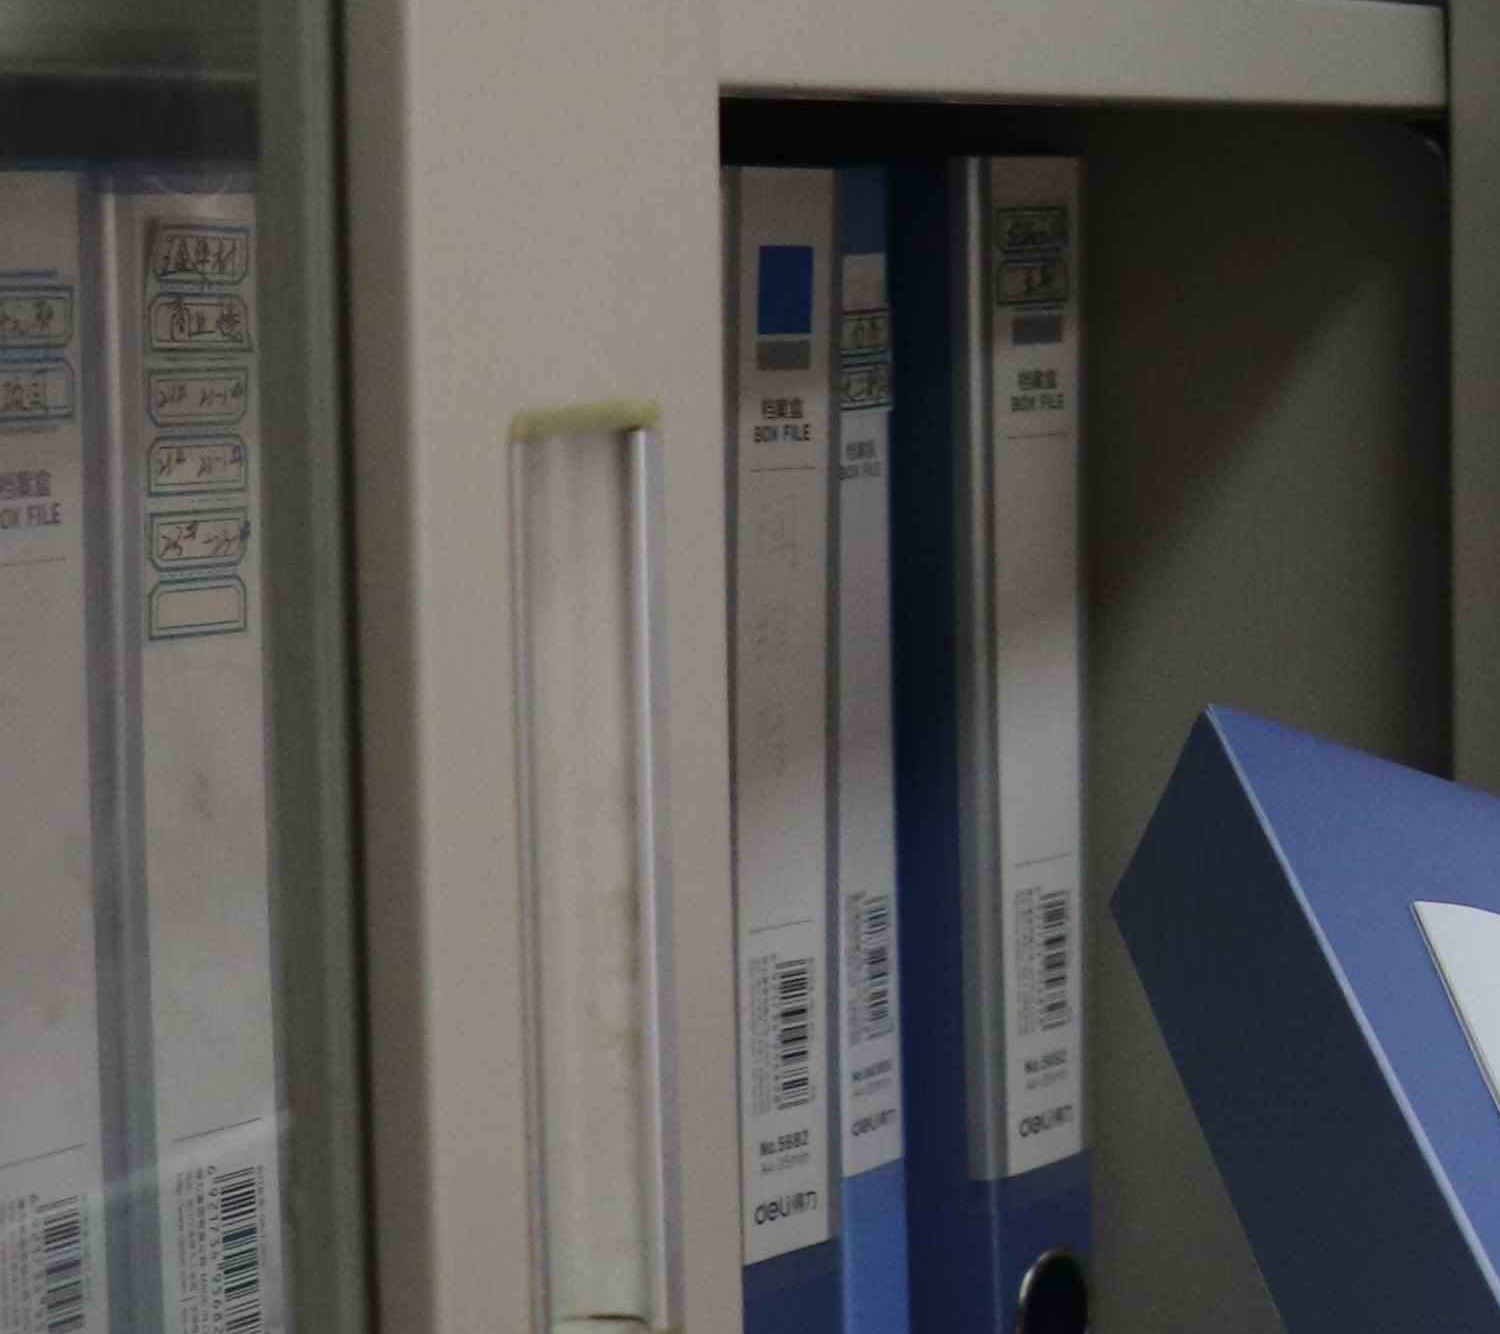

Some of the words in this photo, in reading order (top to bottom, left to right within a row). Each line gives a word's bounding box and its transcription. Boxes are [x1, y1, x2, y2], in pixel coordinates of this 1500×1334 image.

[783, 423, 811, 442] FILE
[27, 502, 62, 526] FILE
[755, 1191, 817, 1225] deli得力
